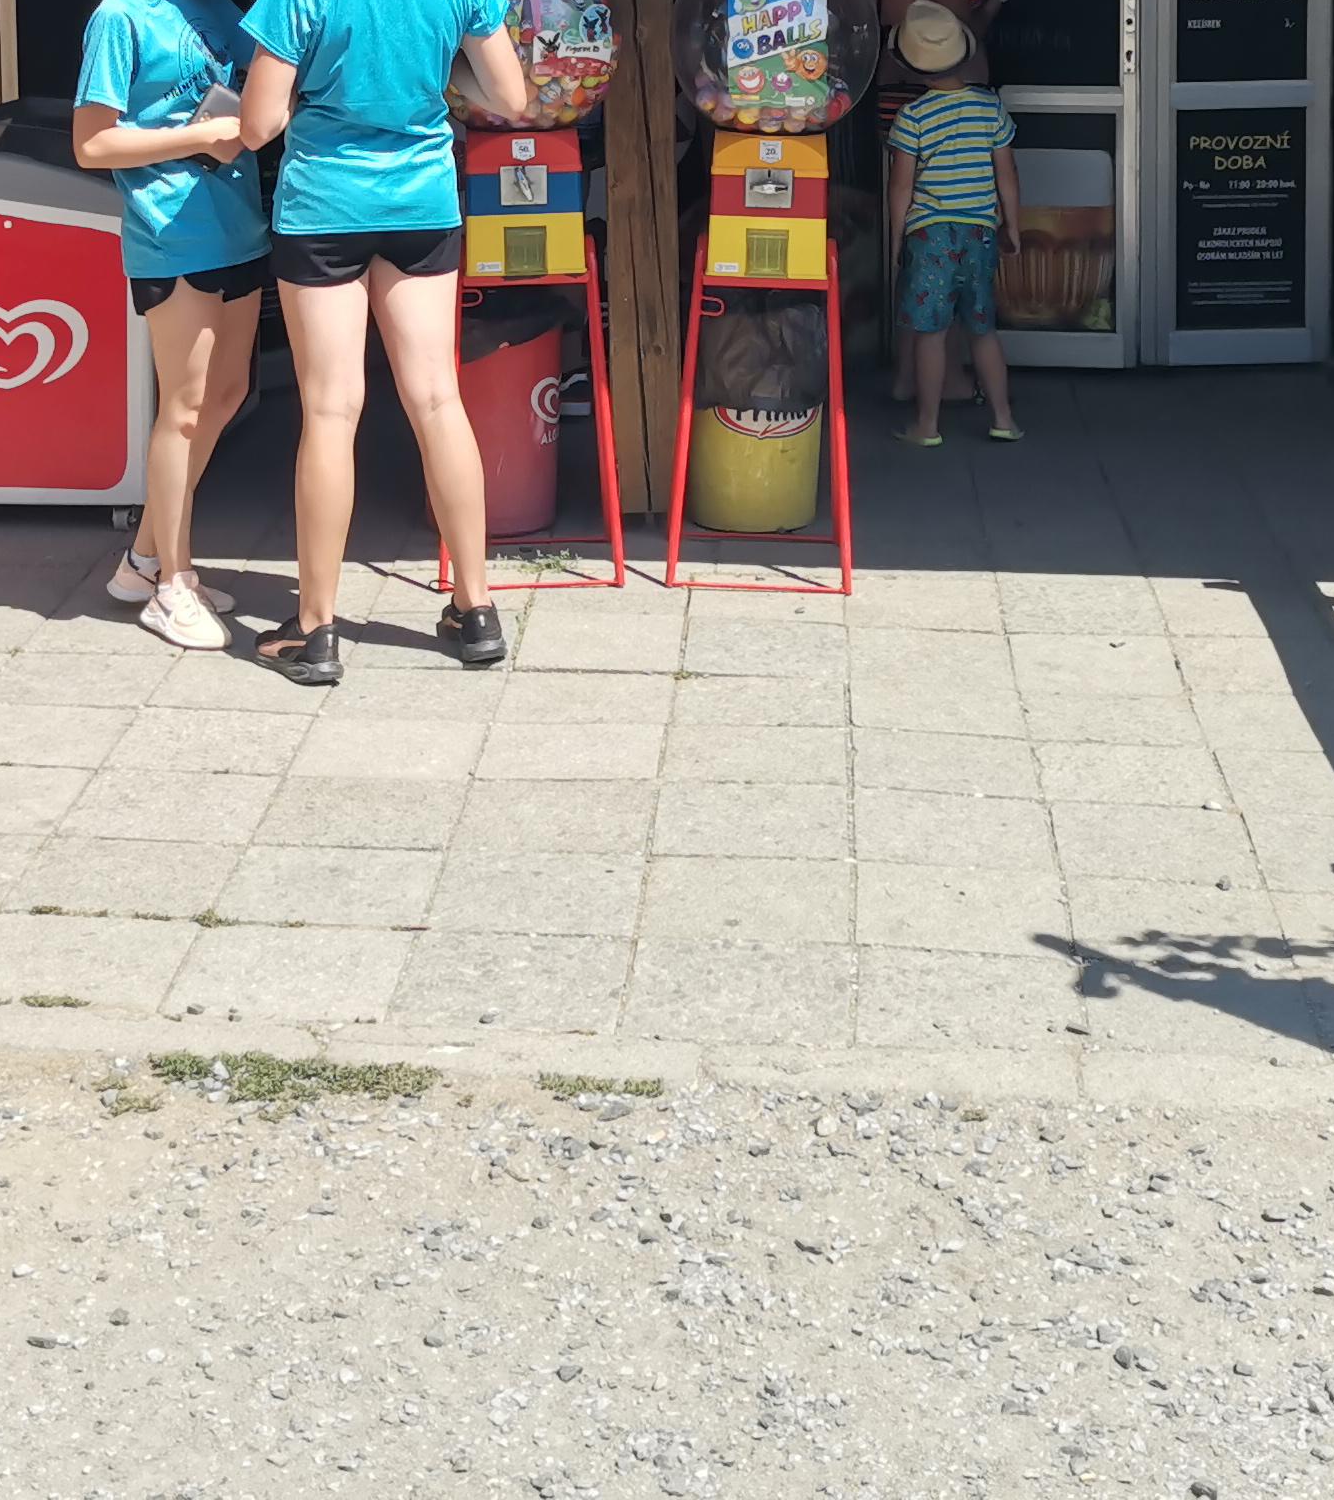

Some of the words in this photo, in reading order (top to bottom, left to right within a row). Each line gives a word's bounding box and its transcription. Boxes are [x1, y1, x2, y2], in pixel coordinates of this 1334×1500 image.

[757, 19, 822, 56] BALLS
[1189, 130, 1291, 151] PROVOZNÍ
[1214, 155, 1267, 171] DOBA
